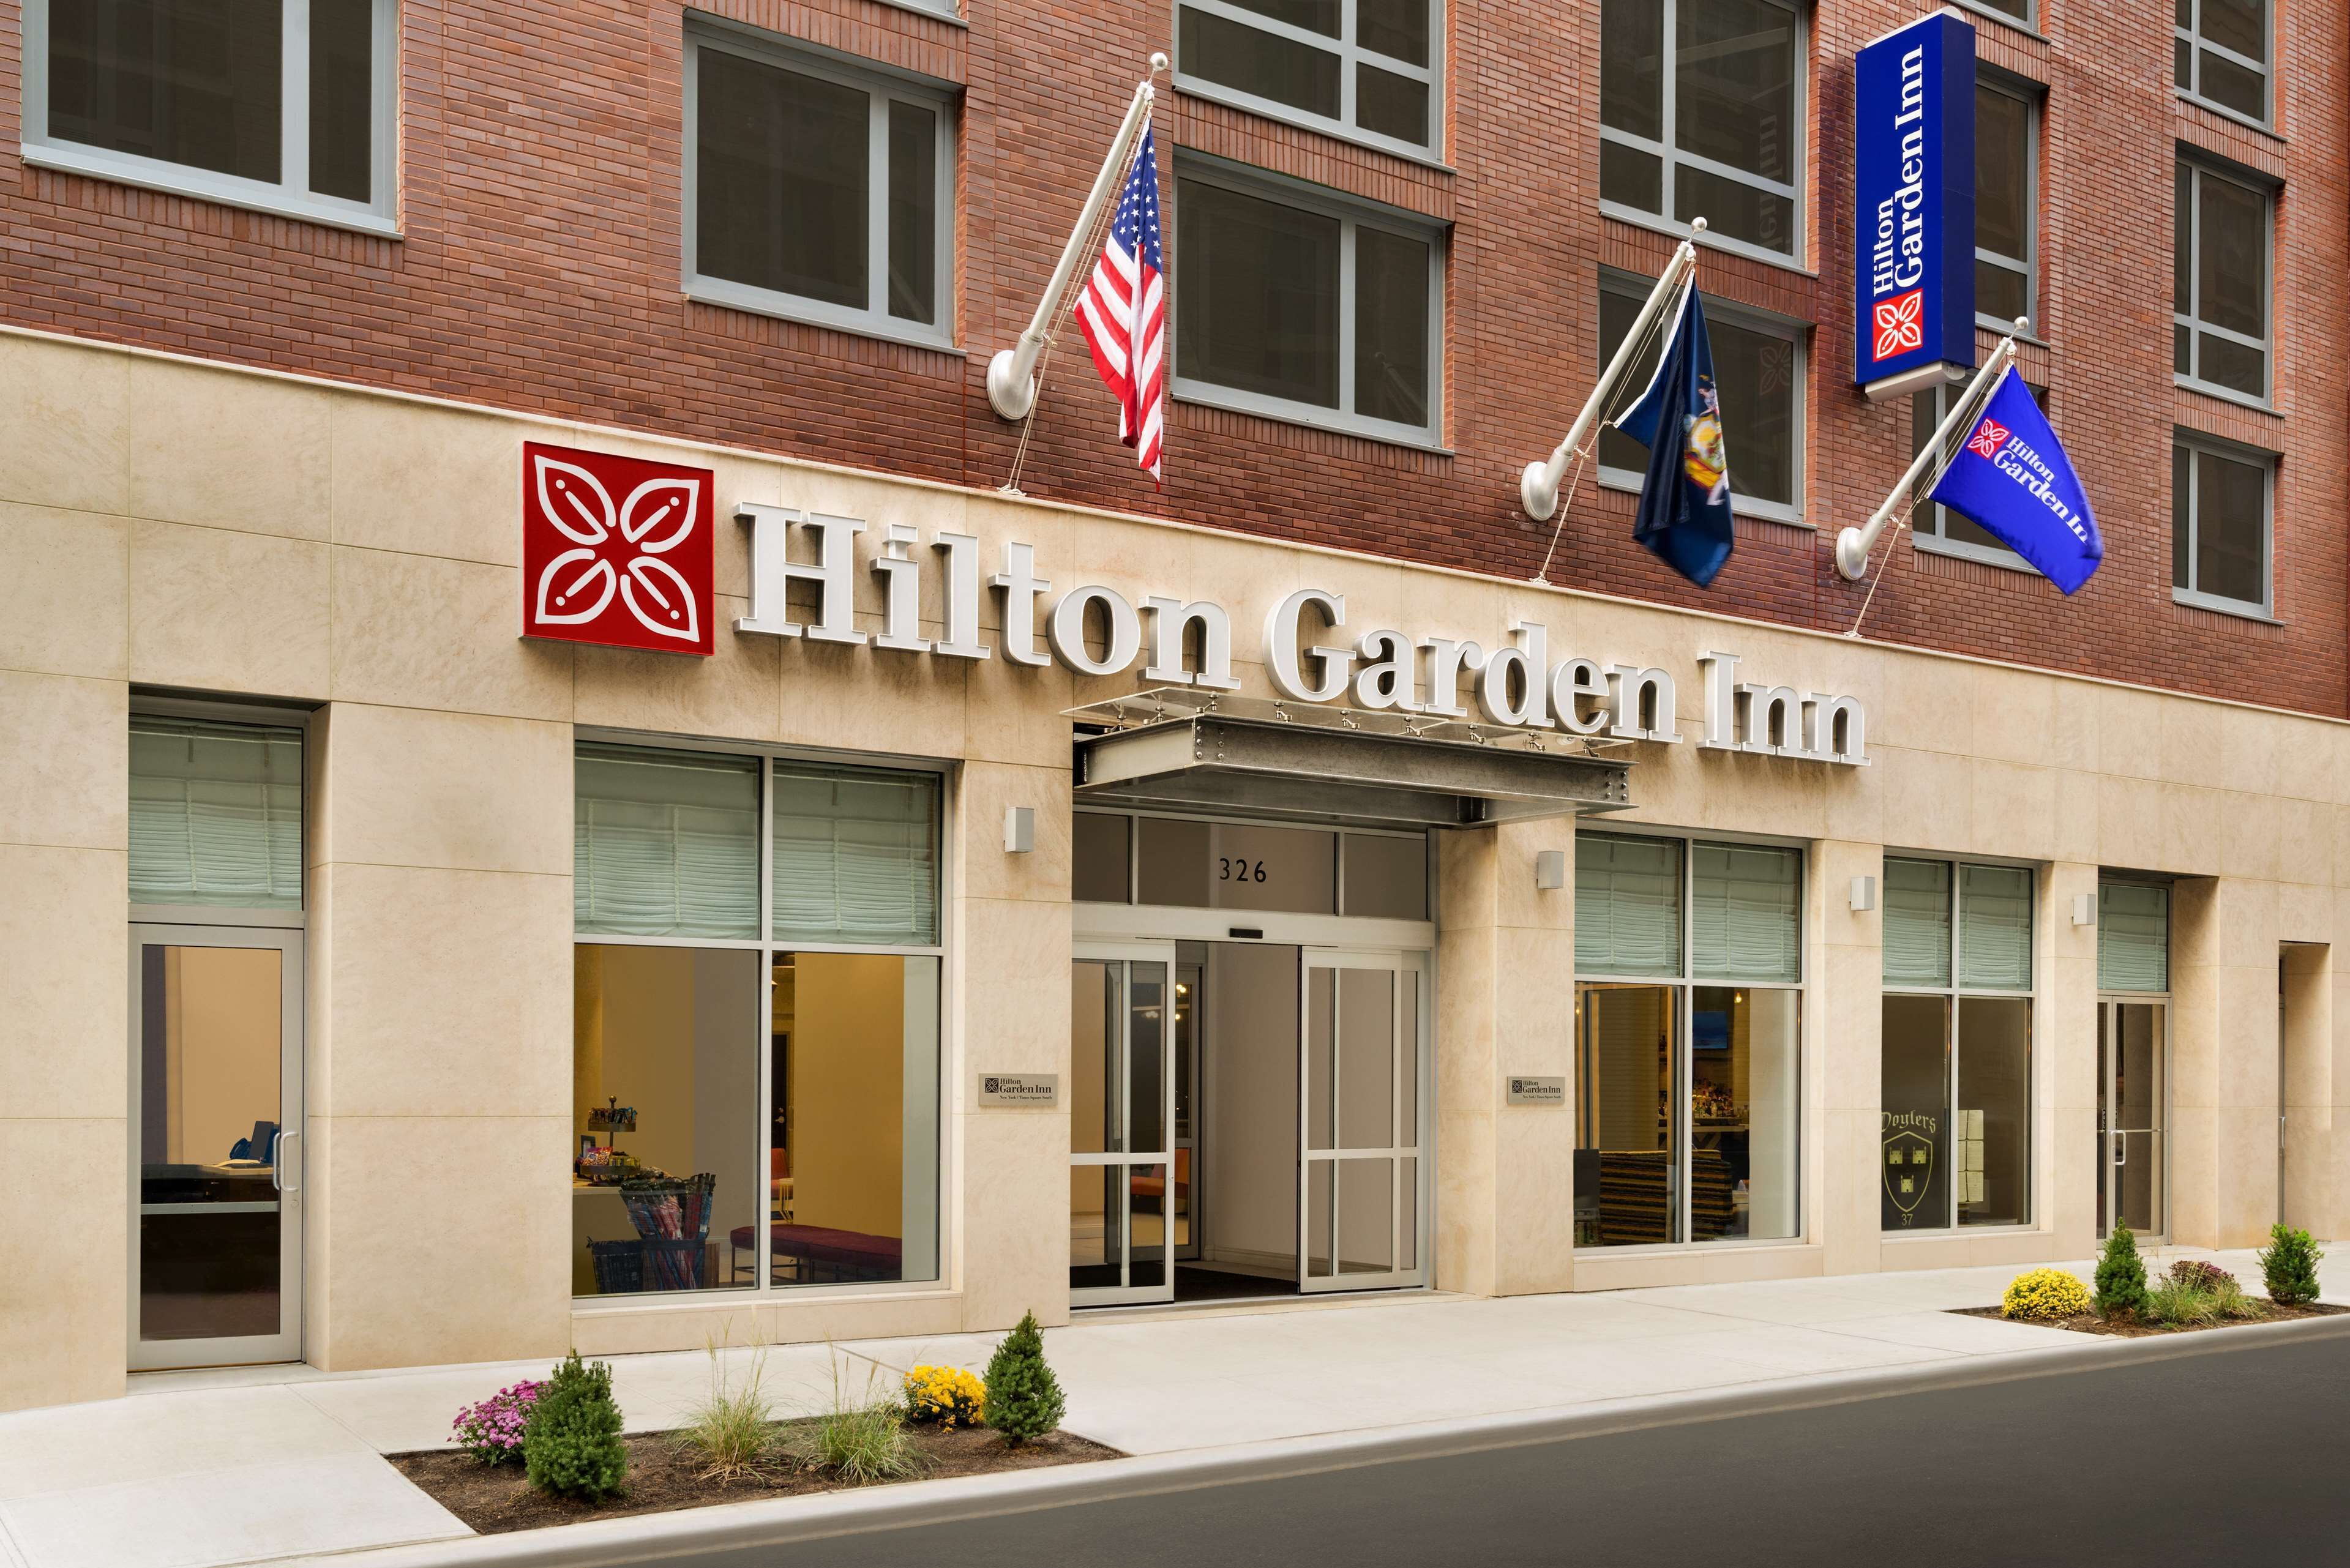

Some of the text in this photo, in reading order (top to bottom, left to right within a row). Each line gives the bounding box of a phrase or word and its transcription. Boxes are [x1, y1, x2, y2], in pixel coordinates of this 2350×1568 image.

[1895, 44, 1923, 288] Garden Inn
[1874, 196, 1893, 297] Hilton
[1993, 449, 2069, 520] Garden
[2005, 435, 2055, 482] Hilton
[733, 501, 1871, 767] Hilton Garden Inn
[1219, 857, 1267, 883] 326
[999, 1085, 1052, 1093] Garden Inn
[1901, 1214, 1914, 1226] 37
